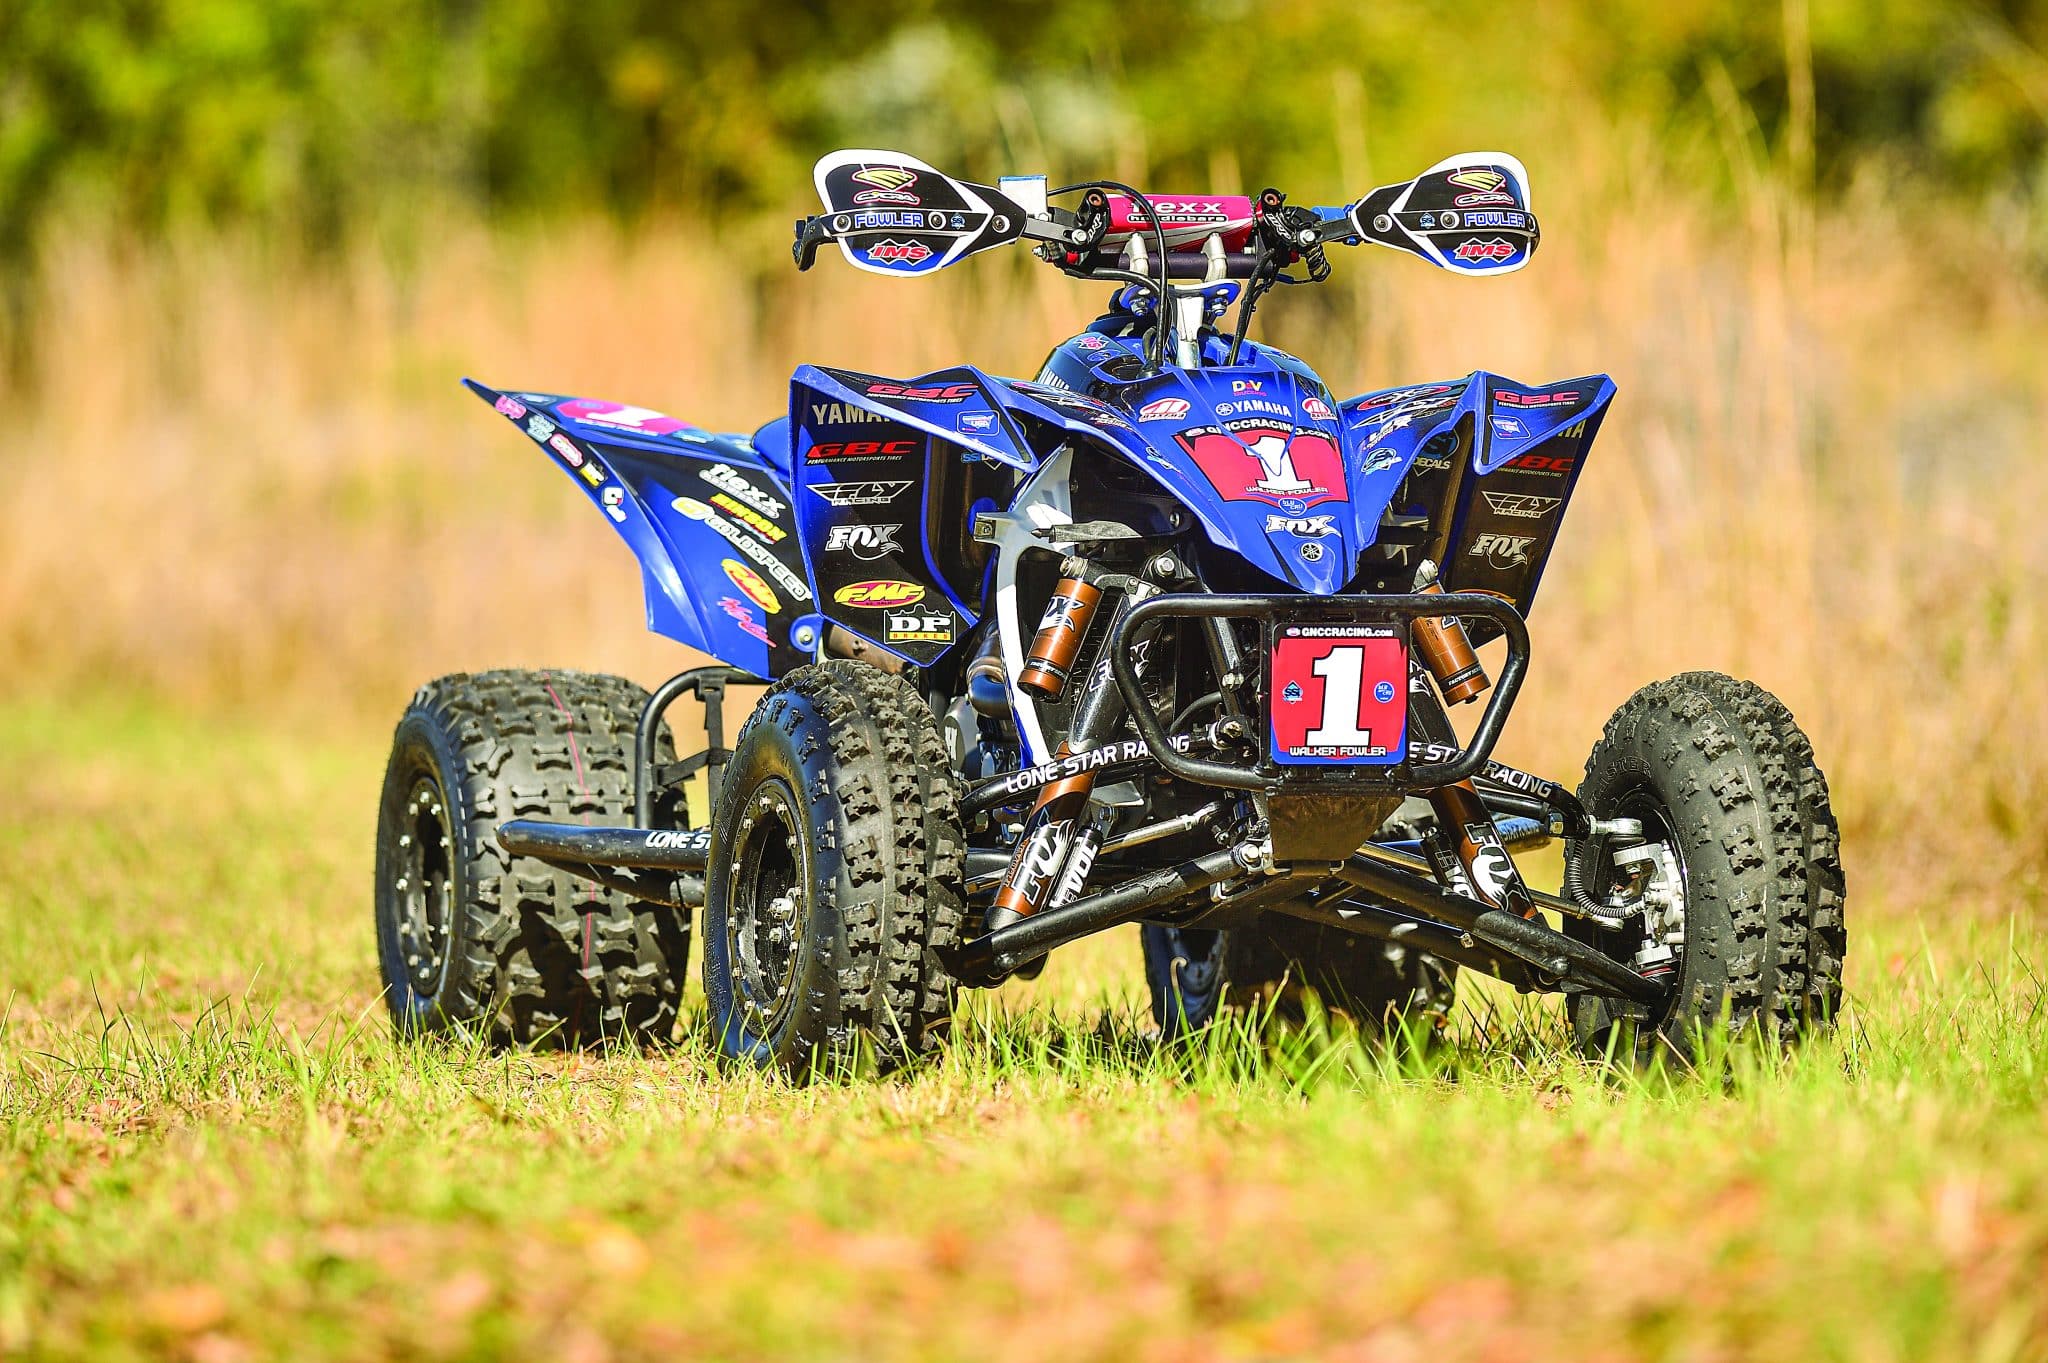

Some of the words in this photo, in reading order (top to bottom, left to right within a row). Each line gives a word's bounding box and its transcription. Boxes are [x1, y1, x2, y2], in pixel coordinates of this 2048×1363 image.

[855, 212, 923, 228] FOWLER
[1464, 212, 1526, 227] FOWLER
[872, 246, 929, 260] IMS
[1459, 245, 1514, 258] IMS
[866, 383, 979, 399] GBC
[1495, 391, 1580, 405] GBC
[1232, 400, 1293, 417] YAMAHA
[807, 441, 917, 458] GBC
[1243, 435, 1313, 491] 1
[806, 481, 914, 500] FLY
[1246, 486, 1285, 495] WALKER
[832, 497, 891, 506] RACING
[1481, 491, 1562, 512] FLY
[1494, 508, 1541, 518] RACING
[1265, 515, 1340, 536] FOX
[825, 524, 904, 553] FOX
[1469, 533, 1536, 561] FOX
[836, 583, 924, 603] FMF
[890, 617, 951, 632] DP
[1302, 627, 1393, 637] GNCCRACING.com
[893, 632, 949, 640] BRAKES
[1306, 646, 1372, 747] 1
[1290, 747, 1337, 756] WALKER
[1340, 747, 1386, 756] FOWLER
[1006, 761, 1058, 793] LONE
[1063, 746, 1117, 776] STAR
[1482, 761, 1552, 799] RACING
[645, 831, 695, 848] LONE
[1011, 820, 1069, 905] FOX
[1464, 821, 1532, 908] FOX
